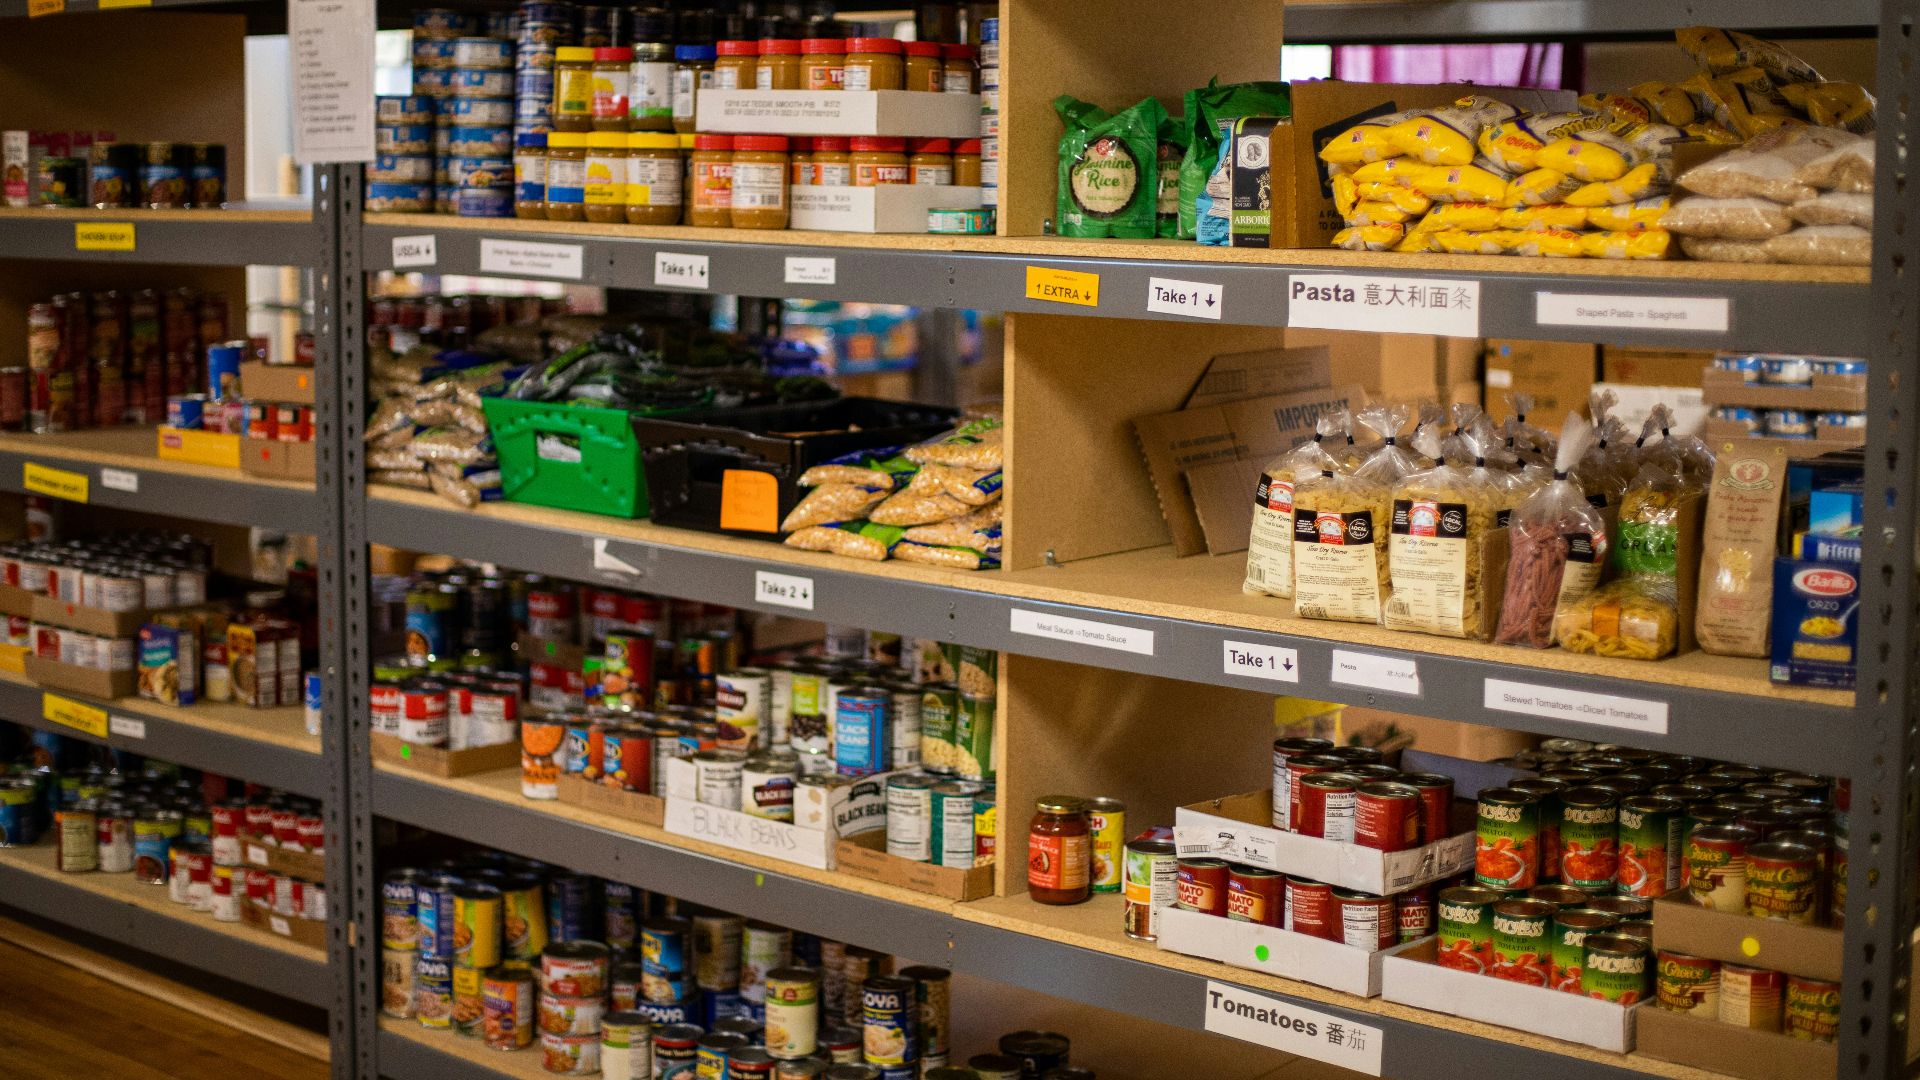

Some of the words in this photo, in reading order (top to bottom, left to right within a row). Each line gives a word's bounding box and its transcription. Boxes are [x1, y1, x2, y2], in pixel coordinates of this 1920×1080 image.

[1074, 157, 1133, 176] Jasmine
[1088, 169, 1120, 190] Rice
[661, 261, 685, 276] Take
[688, 264, 693, 277] 1
[1044, 284, 1079, 300] EXTRA
[1154, 287, 1187, 304] Take
[1192, 294, 1198, 306] 1
[1292, 281, 1355, 303] Pasta
[1363, 282, 1473, 310] 意大利面条
[1576, 307, 1608, 319] Shaped
[1610, 308, 1634, 319] Pasta
[1647, 309, 1687, 321] Spaghetti
[761, 581, 786, 596] Take
[789, 586, 796, 598] 2
[1807, 575, 1850, 589] Barilla
[1808, 601, 1839, 610] ORZO
[1037, 623, 1052, 632] Meat
[1054, 625, 1074, 635] Sauce
[1082, 630, 1104, 640] Tomato
[1106, 633, 1127, 644] Sauce
[1230, 650, 1263, 667] Take
[1269, 656, 1275, 669] 1
[1340, 663, 1357, 671] Pasta
[1503, 694, 1533, 705] Stewed
[1536, 697, 1573, 711] Tomatoes
[1583, 705, 1606, 715] Diced
[1609, 709, 1648, 721] Tomatoes
[837, 809, 864, 827] BLACK
[866, 802, 887, 818] BEAN
[691, 806, 743, 838] BLACK
[750, 820, 797, 850] BEANS
[1177, 884, 1204, 897] MATO
[1177, 894, 1199, 906] AUCE
[1228, 894, 1254, 907] MATO
[1228, 904, 1250, 915] AUCE
[1400, 917, 1425, 928] AUCE
[864, 993, 898, 1008] OYA
[1209, 991, 1318, 1037] Tomatoes
[1326, 1021, 1367, 1051] 番茄
